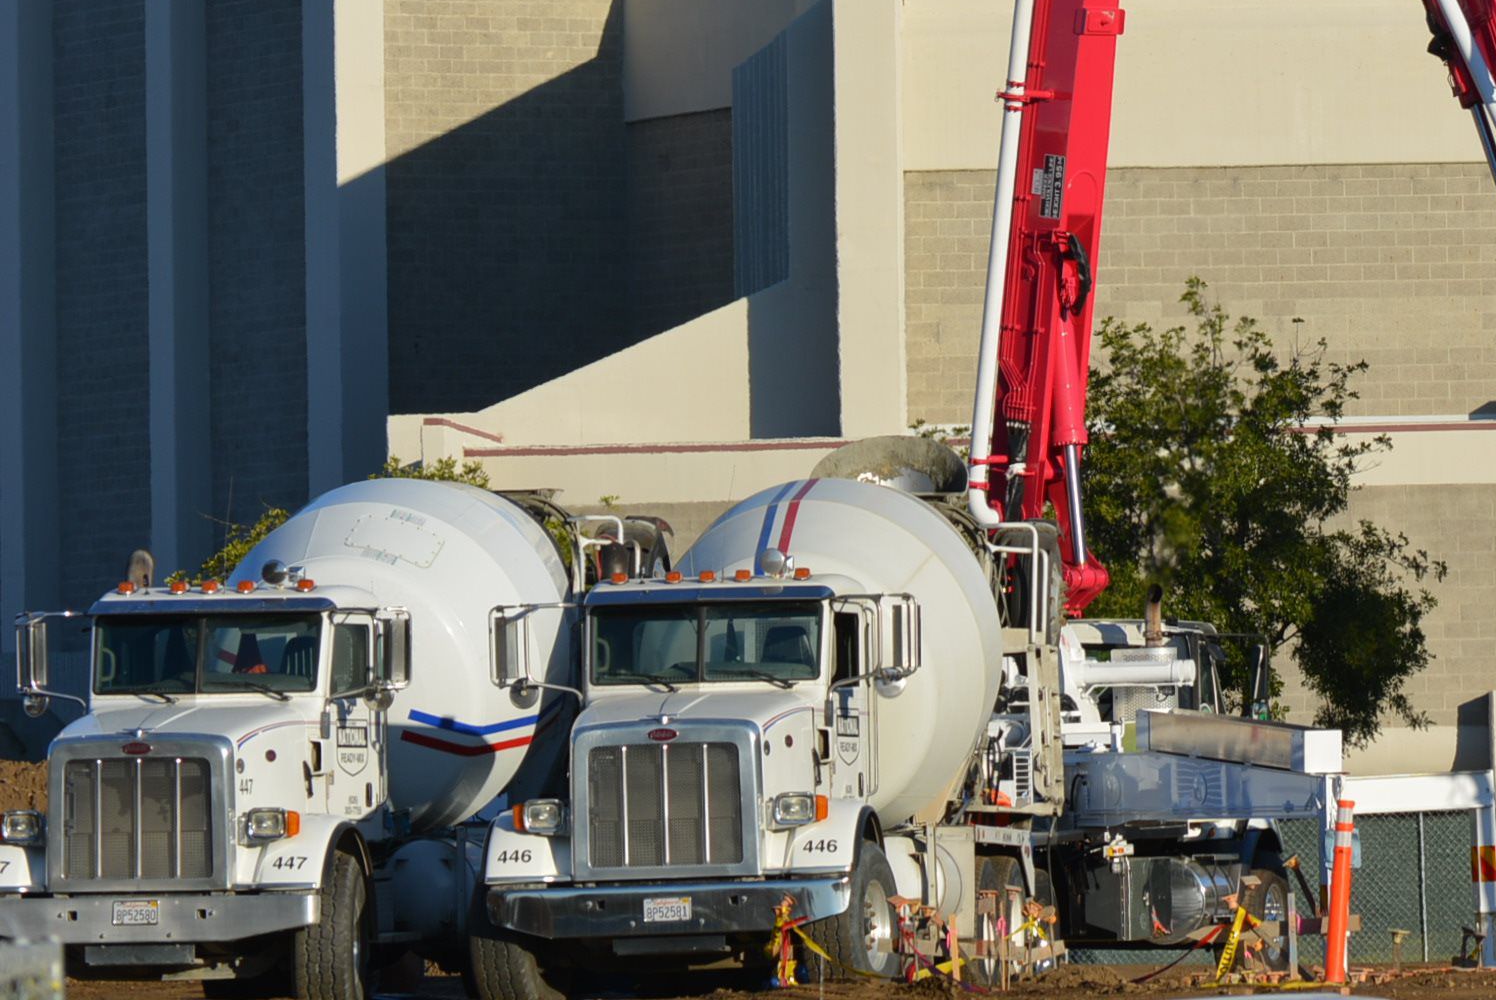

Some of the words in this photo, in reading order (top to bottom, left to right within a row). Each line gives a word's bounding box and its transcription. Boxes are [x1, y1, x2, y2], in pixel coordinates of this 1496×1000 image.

[239, 778, 253, 795] 447
[803, 839, 838, 853] 446
[272, 855, 307, 871] 447
[497, 849, 532, 863] 446
[116, 908, 156, 921] 8P52580
[646, 906, 688, 919] 8P52581
